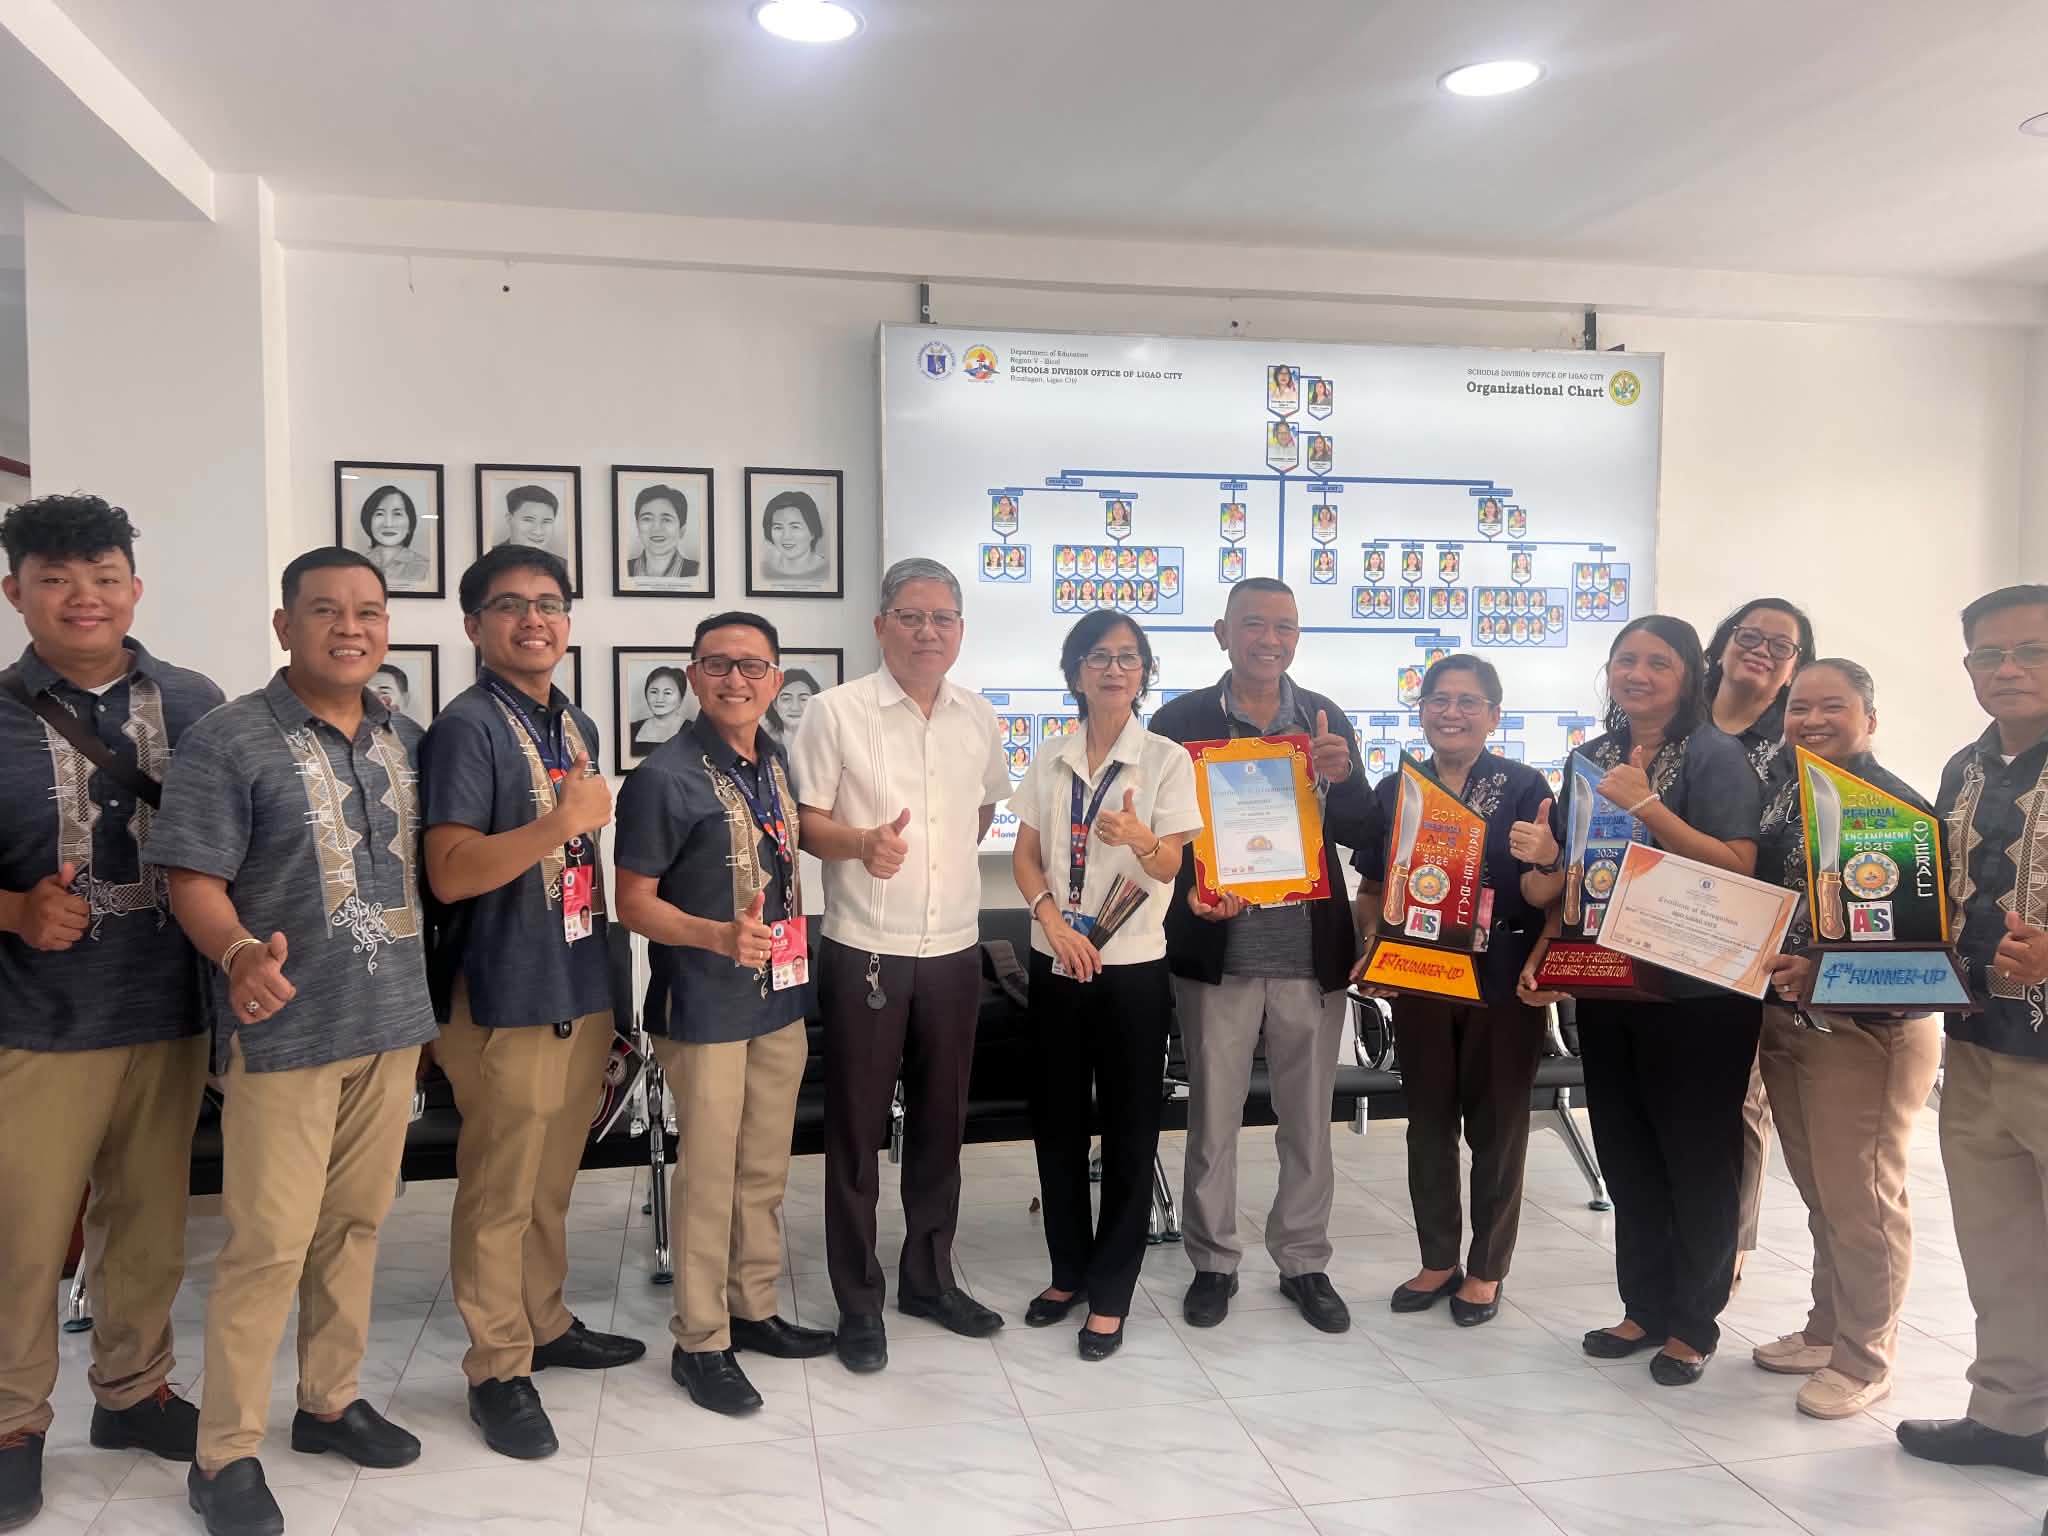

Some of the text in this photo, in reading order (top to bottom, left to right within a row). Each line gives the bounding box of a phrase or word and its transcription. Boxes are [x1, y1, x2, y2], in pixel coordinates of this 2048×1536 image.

[1010, 365, 1183, 380] SCHOOLS DIVISION OFFICE OF LIGAO CITY
[1467, 368, 1500, 376] SCHOOLS
[1501, 369, 1530, 377] DIVISION
[1531, 371, 1557, 379] OFFICE
[1568, 372, 1589, 380] LIGAO
[1590, 373, 1605, 381] CITY
[1466, 381, 1605, 397] Organizational Chart
[992, 813, 1017, 824] SDO
[1843, 807, 1898, 818] REGIONAL
[1853, 818, 1888, 830] ALS
[1844, 831, 1911, 842] ENCAMPMENT
[1912, 820, 1934, 898] OVERALL
[1393, 956, 1465, 981] RUNNER-UP
[1847, 967, 1947, 985] RUNNER-UP
